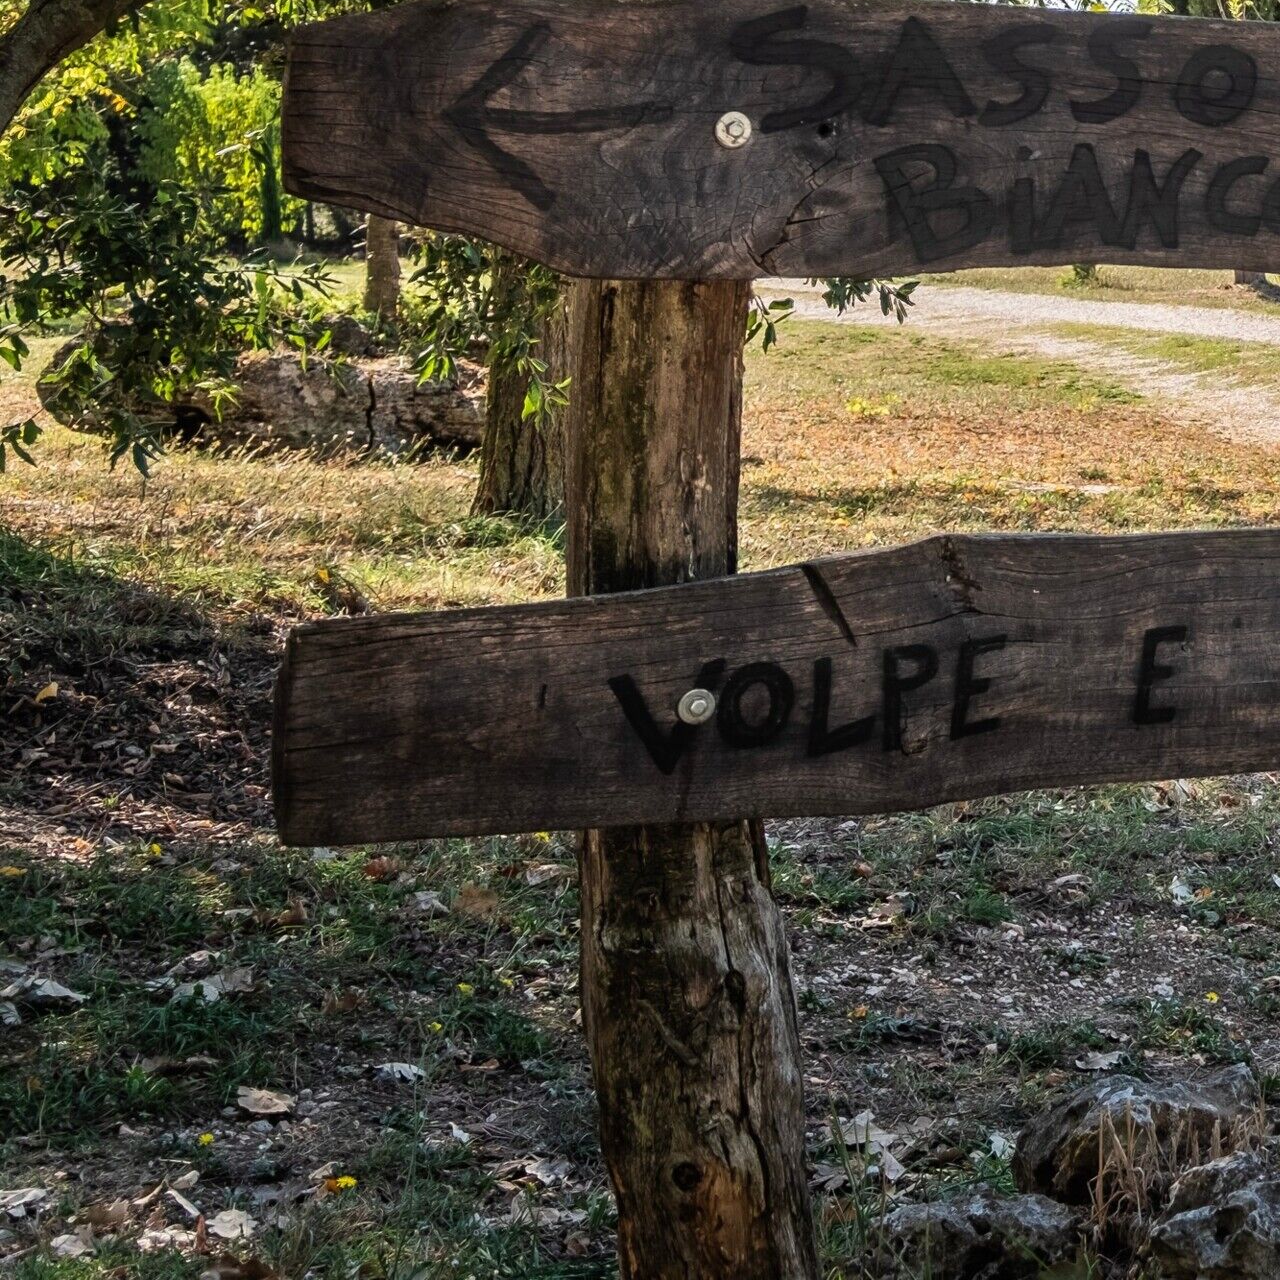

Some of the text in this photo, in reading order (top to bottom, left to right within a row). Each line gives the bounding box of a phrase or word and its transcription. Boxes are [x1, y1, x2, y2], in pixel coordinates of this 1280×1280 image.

[729, 6, 1258, 135] SASSO
[608, 634, 1008, 776] VOLPE
[1134, 624, 1189, 728] E
